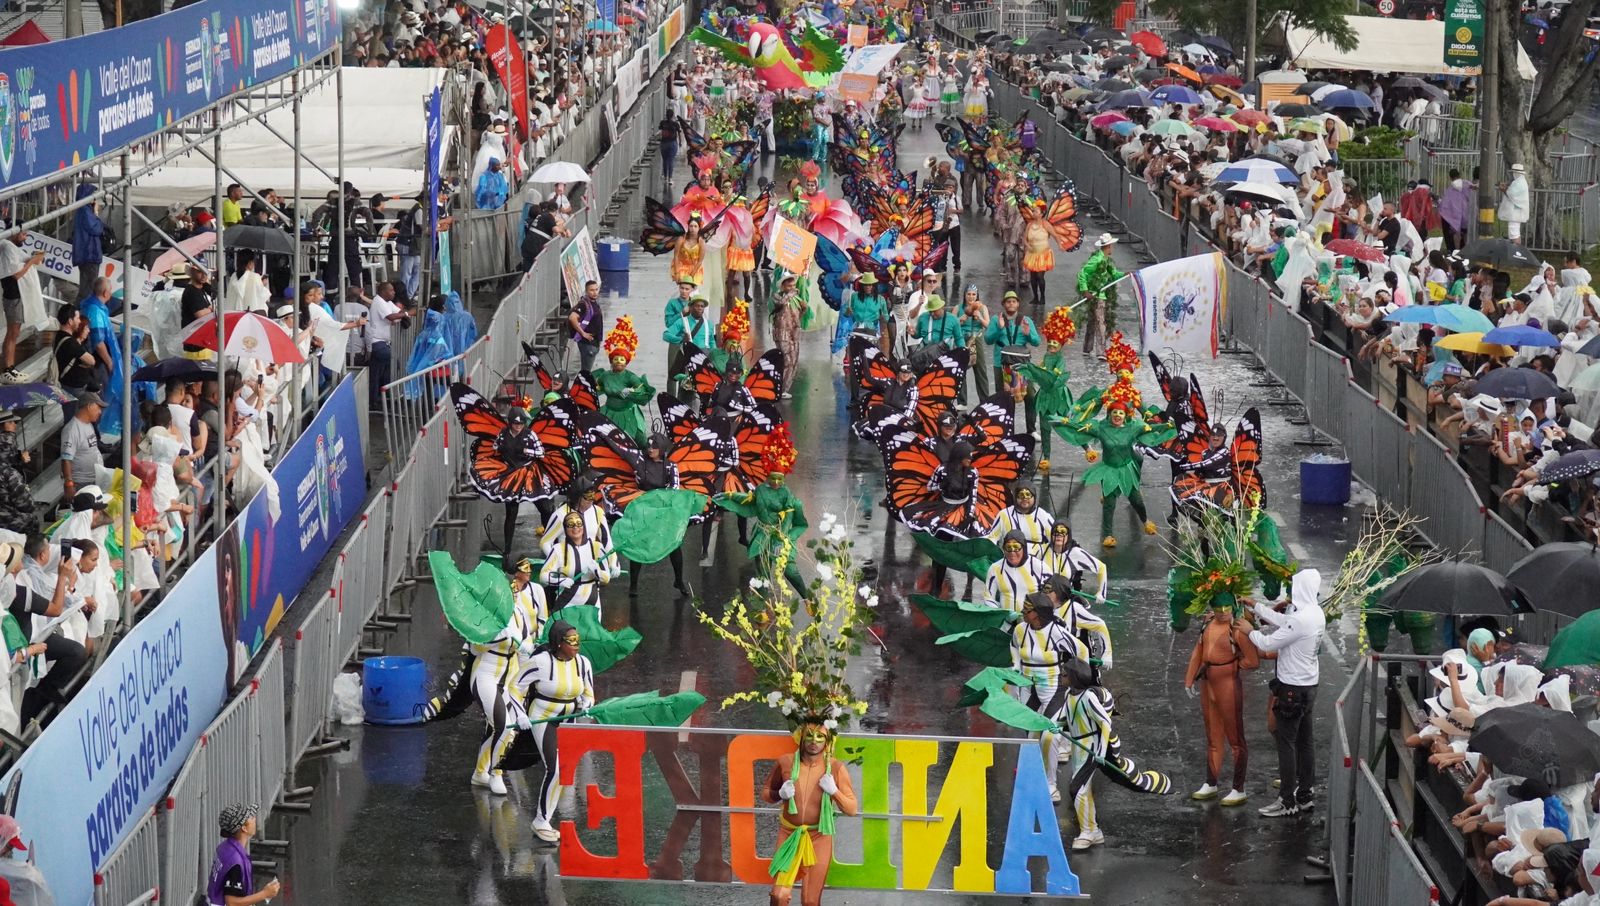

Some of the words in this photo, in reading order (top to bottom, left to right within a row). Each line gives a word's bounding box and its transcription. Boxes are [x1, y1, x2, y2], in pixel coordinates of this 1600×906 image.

[1381, 2, 1392, 10] 50
[251, 12, 264, 40] Valle
[272, 9, 288, 32] Cauca
[278, 33, 290, 60] todos
[99, 61, 118, 97] Valle
[120, 56, 130, 89] del
[130, 55, 152, 86] Cauca
[99, 93, 126, 147] paraíso
[127, 93, 135, 124] de
[136, 86, 154, 119] todos
[24, 234, 72, 260] Cauca
[79, 687, 118, 782] Valle
[118, 650, 140, 735] del
[140, 618, 182, 706] Cauca
[86, 743, 139, 875] paraíso
[140, 722, 155, 792] de
[155, 686, 189, 768] todos
